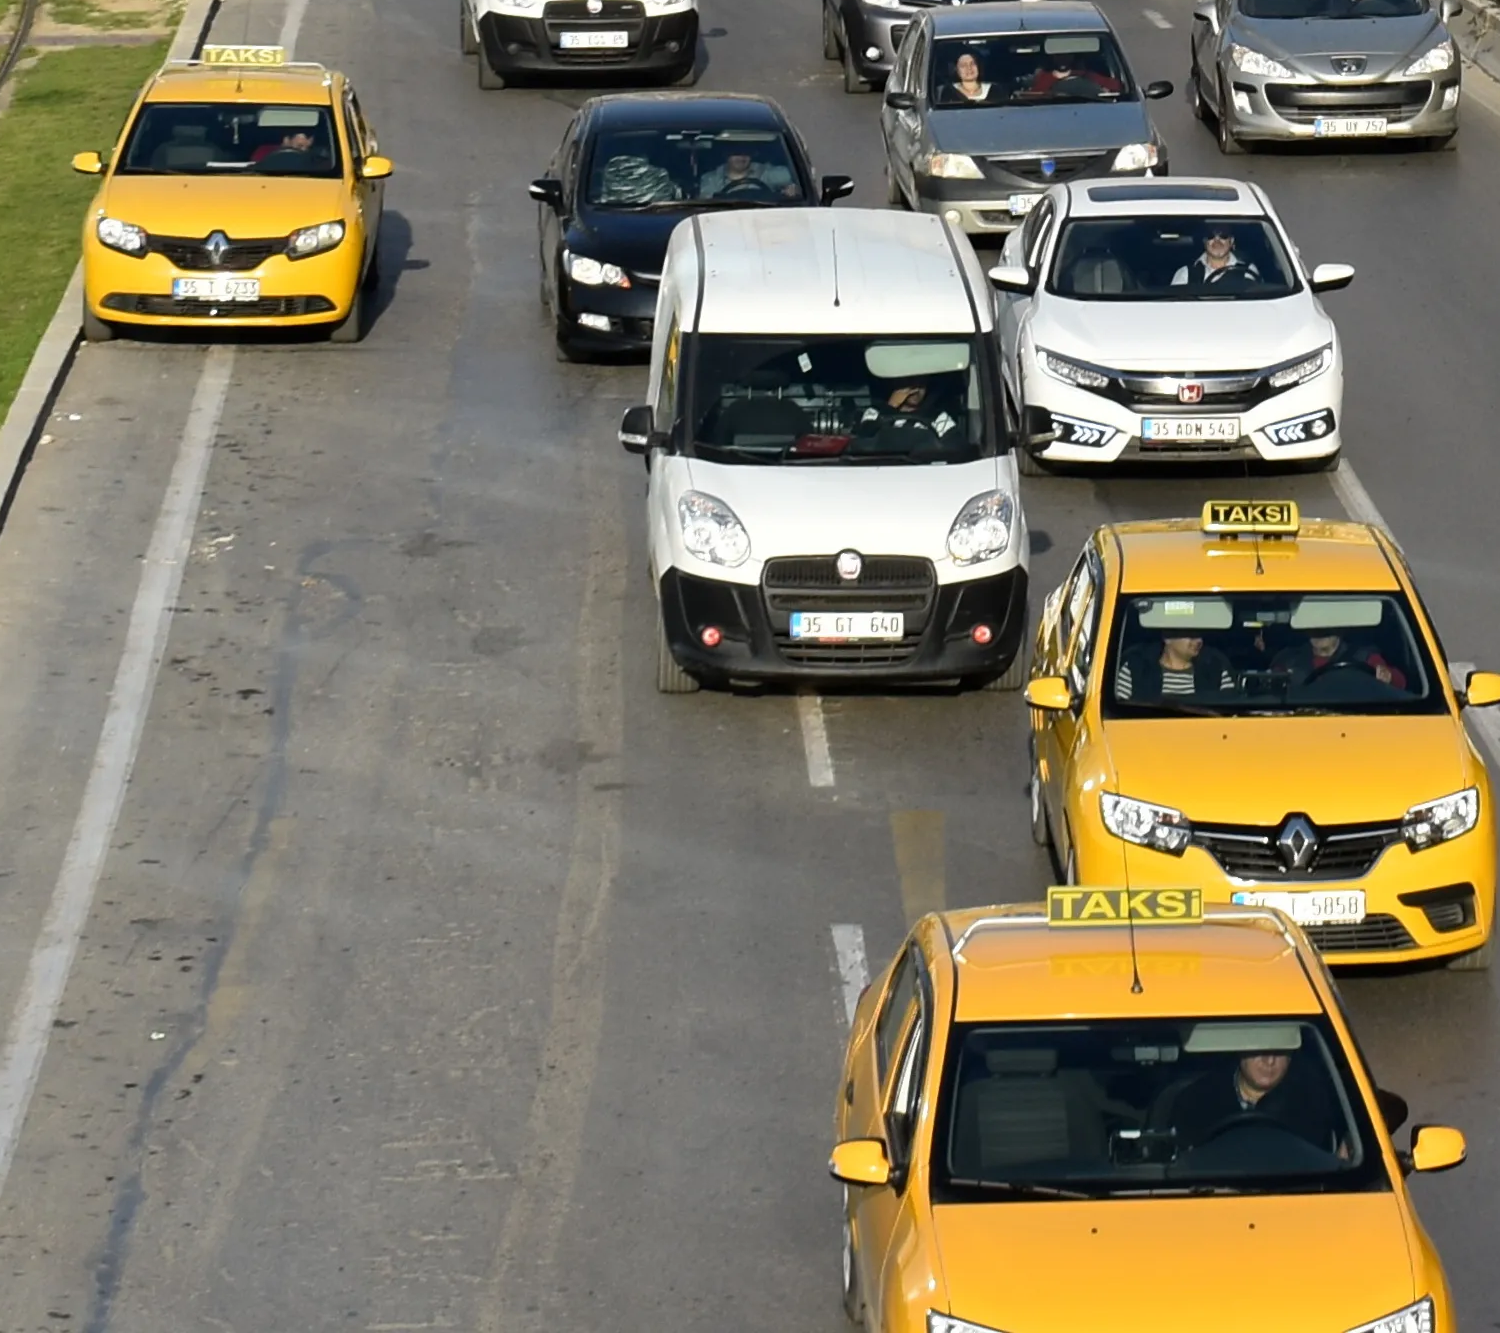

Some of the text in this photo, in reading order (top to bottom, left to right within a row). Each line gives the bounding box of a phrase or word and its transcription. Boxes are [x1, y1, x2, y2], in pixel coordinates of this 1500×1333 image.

[1324, 121, 1336, 132] 35
[183, 281, 197, 294] 35
[208, 281, 215, 294] T
[1153, 422, 1169, 436] 35
[1209, 422, 1235, 436] 543
[802, 617, 898, 633] 35 GT 640
[1311, 896, 1359, 916] 5858
